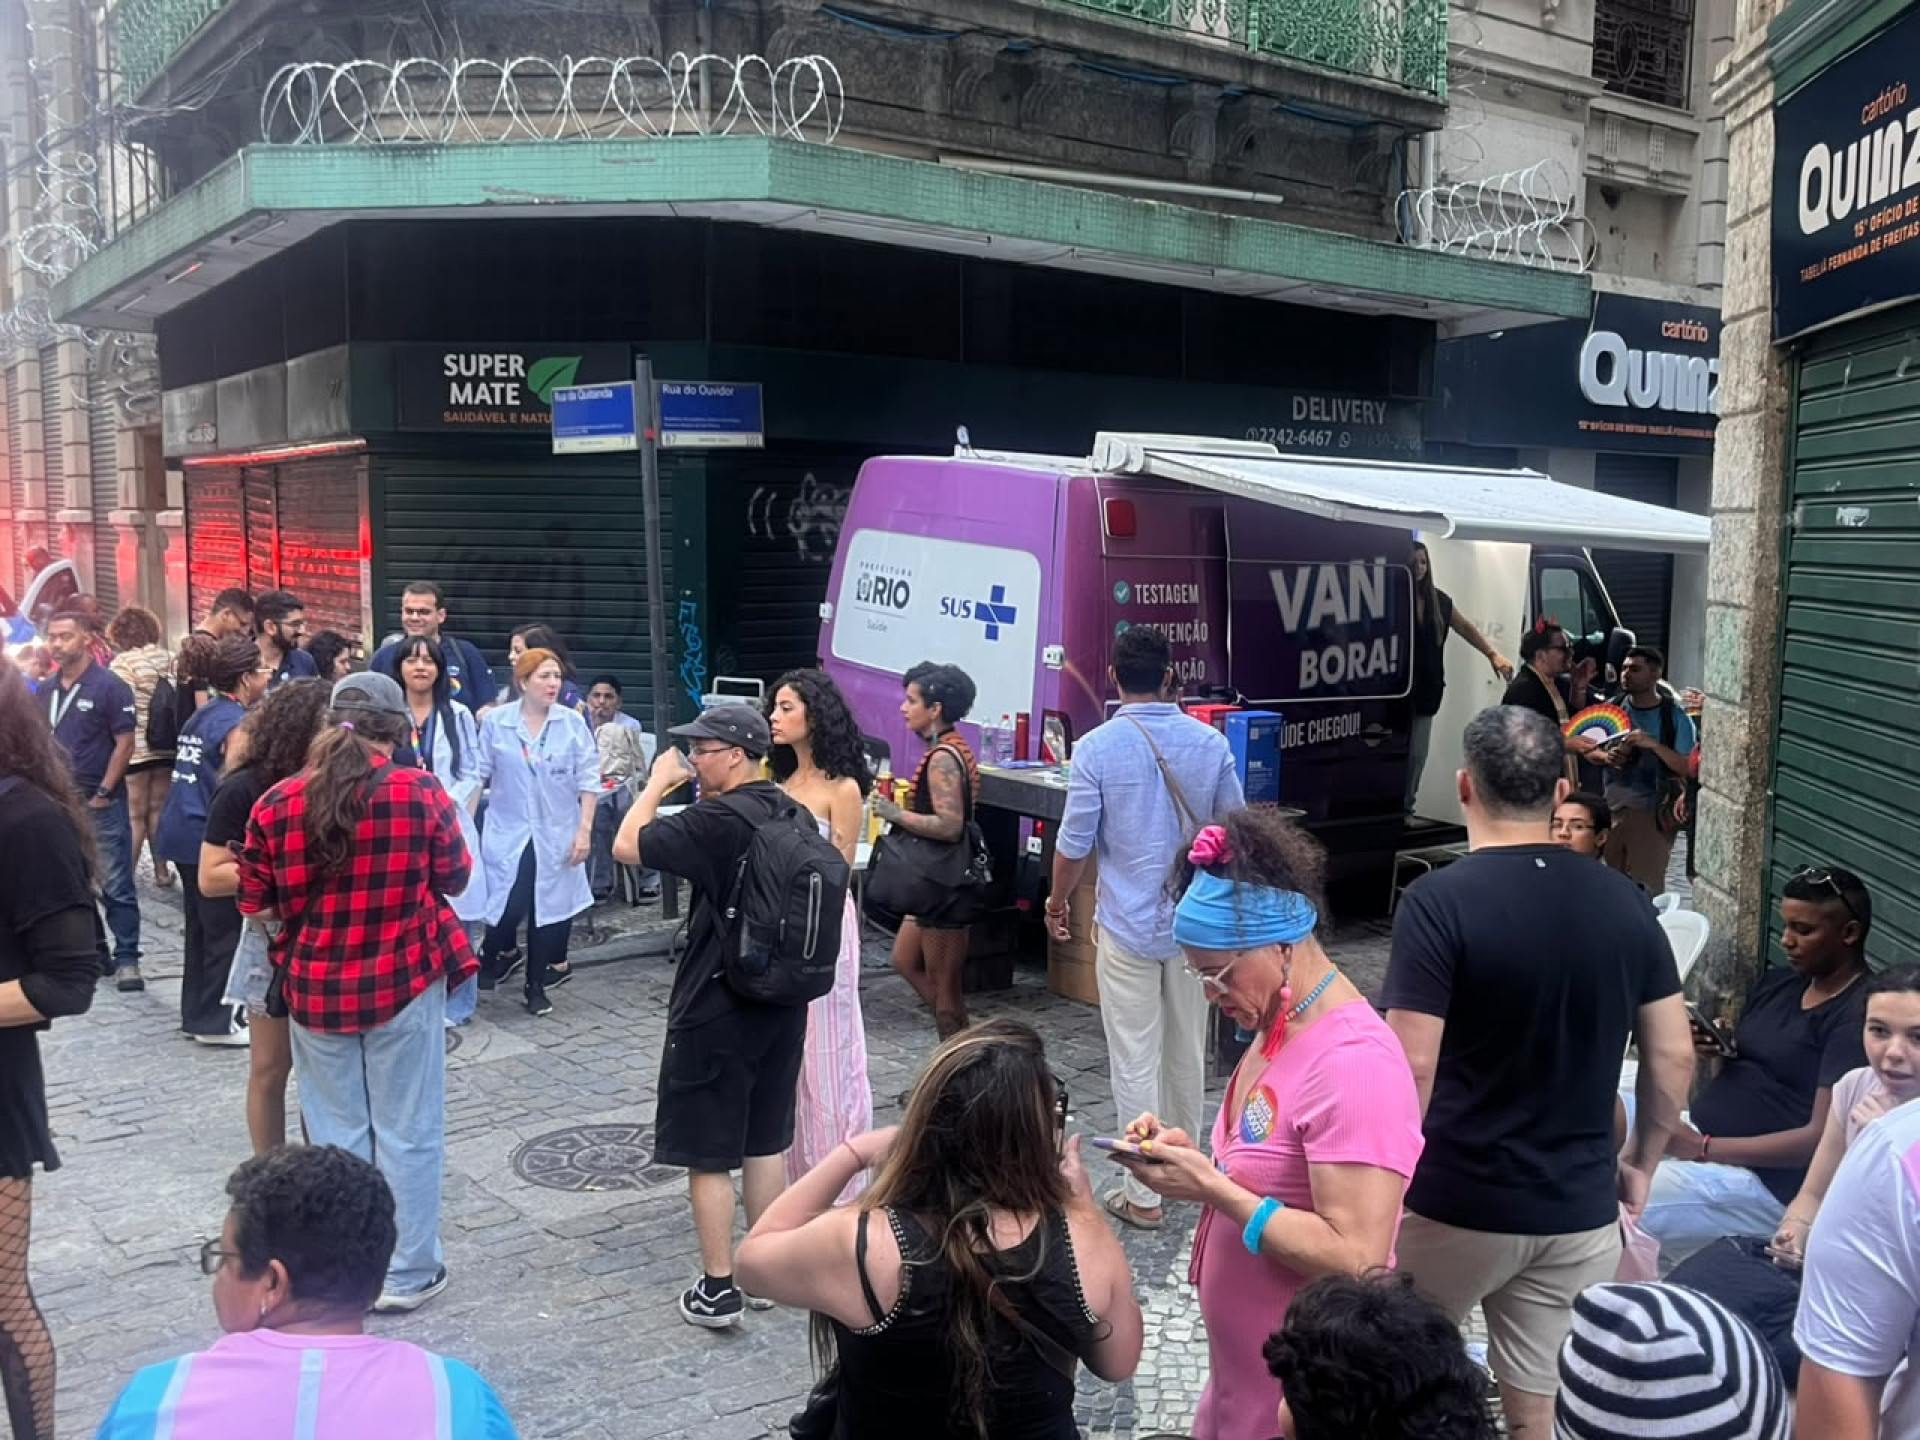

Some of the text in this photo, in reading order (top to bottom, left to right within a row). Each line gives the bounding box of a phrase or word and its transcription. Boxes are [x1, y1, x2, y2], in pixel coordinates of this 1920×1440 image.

[1861, 81, 1908, 125] cartório
[1870, 204, 1903, 231] OFÍCIO
[1883, 221, 1920, 249] FREITAS
[1661, 319, 1709, 343] cartório
[443, 353, 526, 378] SUPER
[449, 382, 521, 406] MATE
[663, 384, 735, 397] Rua do Ouvidor
[443, 411, 552, 424] SAUDÁVEL E NATU
[1292, 395, 1387, 426] DELIVERY
[860, 560, 912, 577] PREFEITURA
[872, 576, 910, 610] RIO
[1134, 583, 1200, 605] TESTAGEM
[1268, 557, 1387, 634] VAN
[939, 596, 972, 619] SUS
[1136, 618, 1209, 646] EVENÇÃO
[1299, 635, 1399, 690] BORA!
[1280, 711, 1361, 750] ÚDE CHEGOU!
